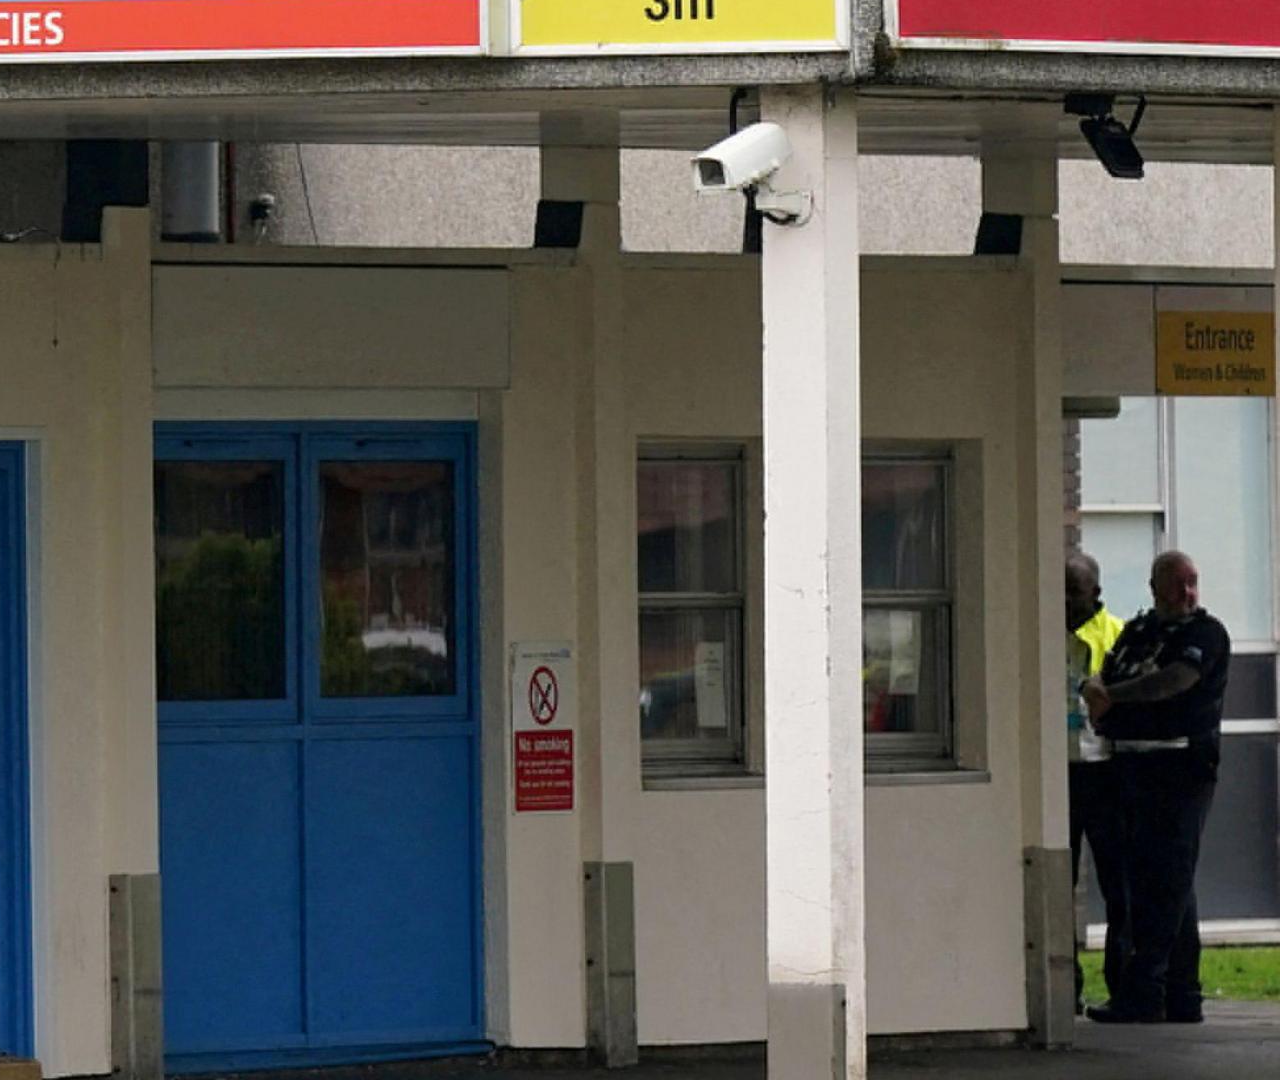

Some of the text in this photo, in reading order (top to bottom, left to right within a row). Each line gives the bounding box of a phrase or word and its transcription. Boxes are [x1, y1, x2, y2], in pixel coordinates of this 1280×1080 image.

[1184, 321, 1255, 351] Entrance
[519, 735, 570, 754] No smoking
